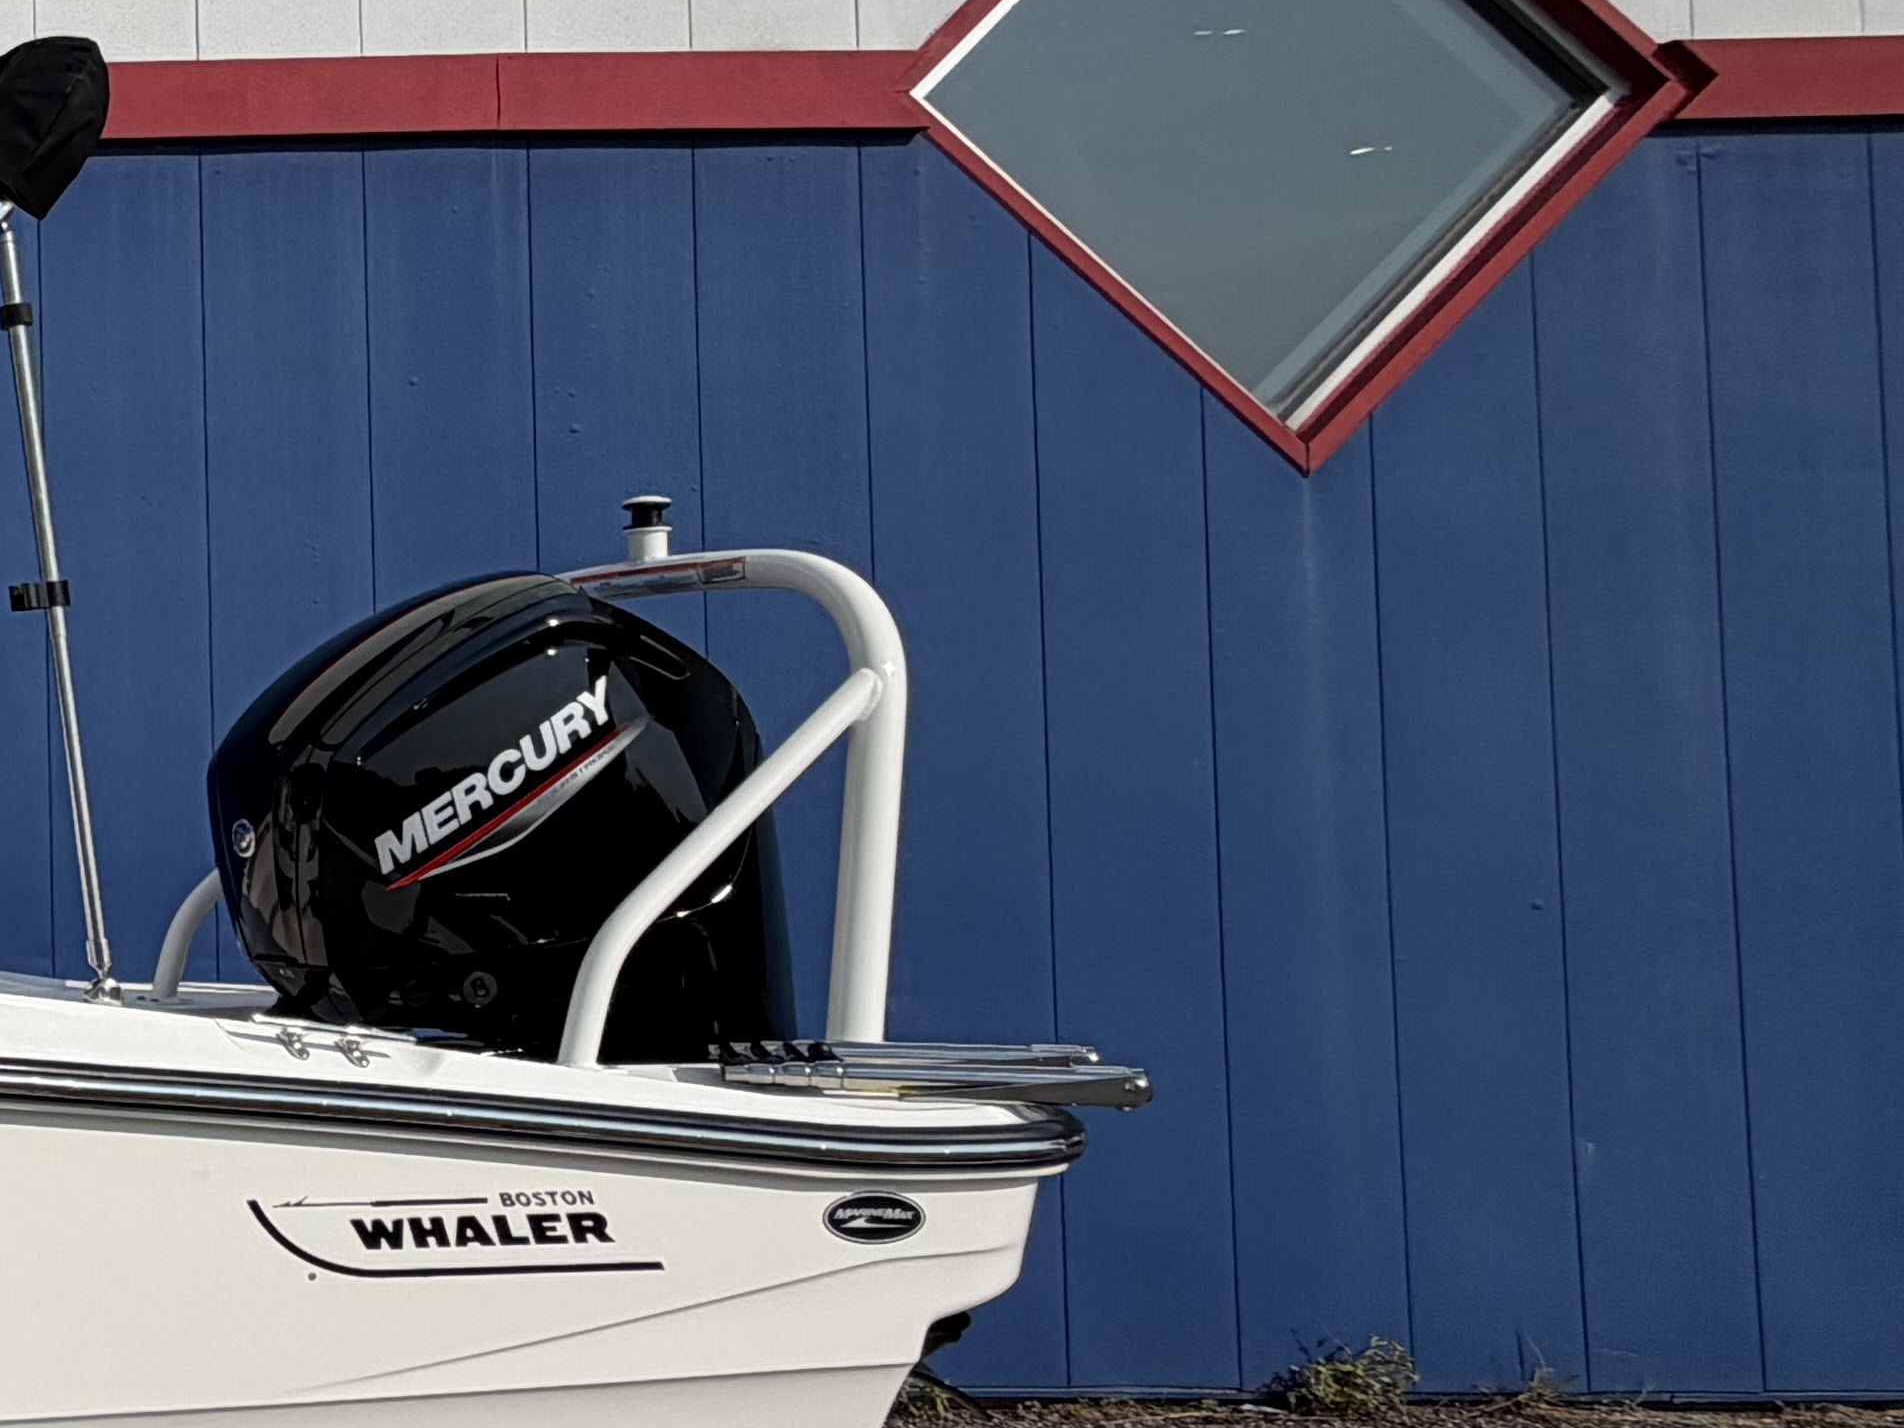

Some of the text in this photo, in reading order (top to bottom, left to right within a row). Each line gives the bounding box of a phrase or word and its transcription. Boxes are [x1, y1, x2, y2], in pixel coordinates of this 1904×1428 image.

[374, 675, 609, 875] MERCURY
[498, 1190, 595, 1208] BOSTON
[349, 1212, 616, 1250] WHALER
